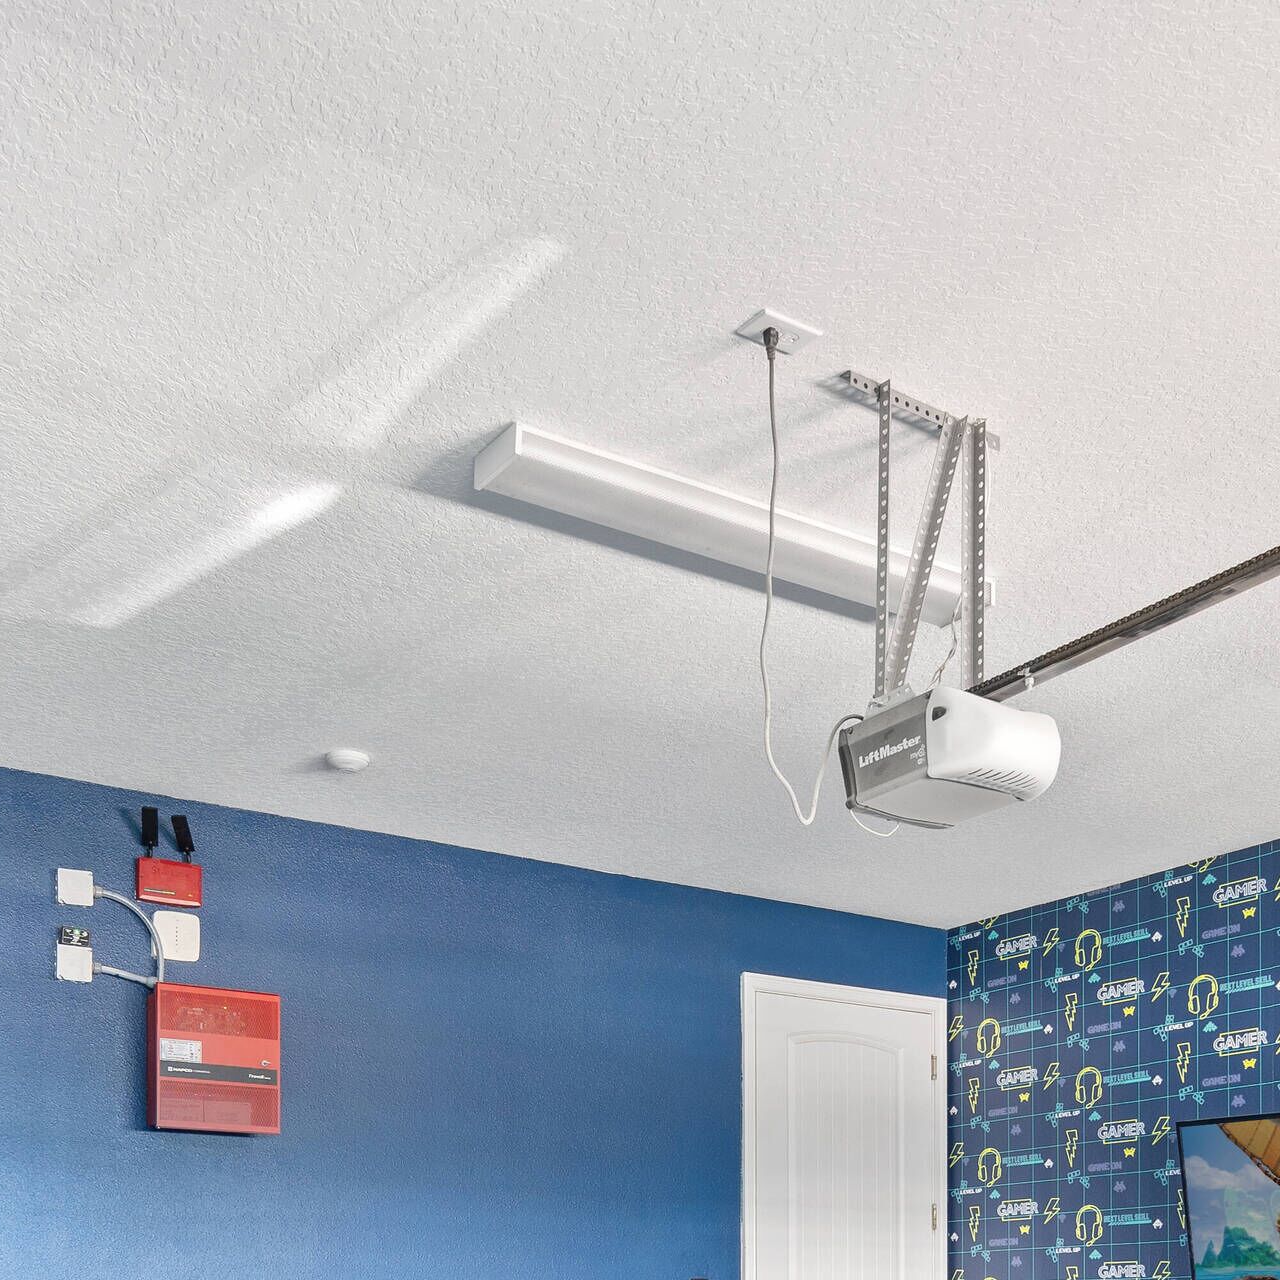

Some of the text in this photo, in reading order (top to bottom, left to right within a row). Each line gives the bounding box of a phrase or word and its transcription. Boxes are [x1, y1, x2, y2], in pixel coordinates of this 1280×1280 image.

[859, 736, 921, 768] LiftMaster
[1212, 878, 1267, 902] GAMER
[995, 935, 1037, 956] GAMER
[1097, 979, 1144, 1000] GAMER
[1213, 1030, 1267, 1051] GAMER
[996, 1068, 1038, 1086] GAMER
[1098, 1121, 1145, 1139] GAMER
[997, 1201, 1038, 1216] GAMER
[1098, 1264, 1145, 1278] GAMER
